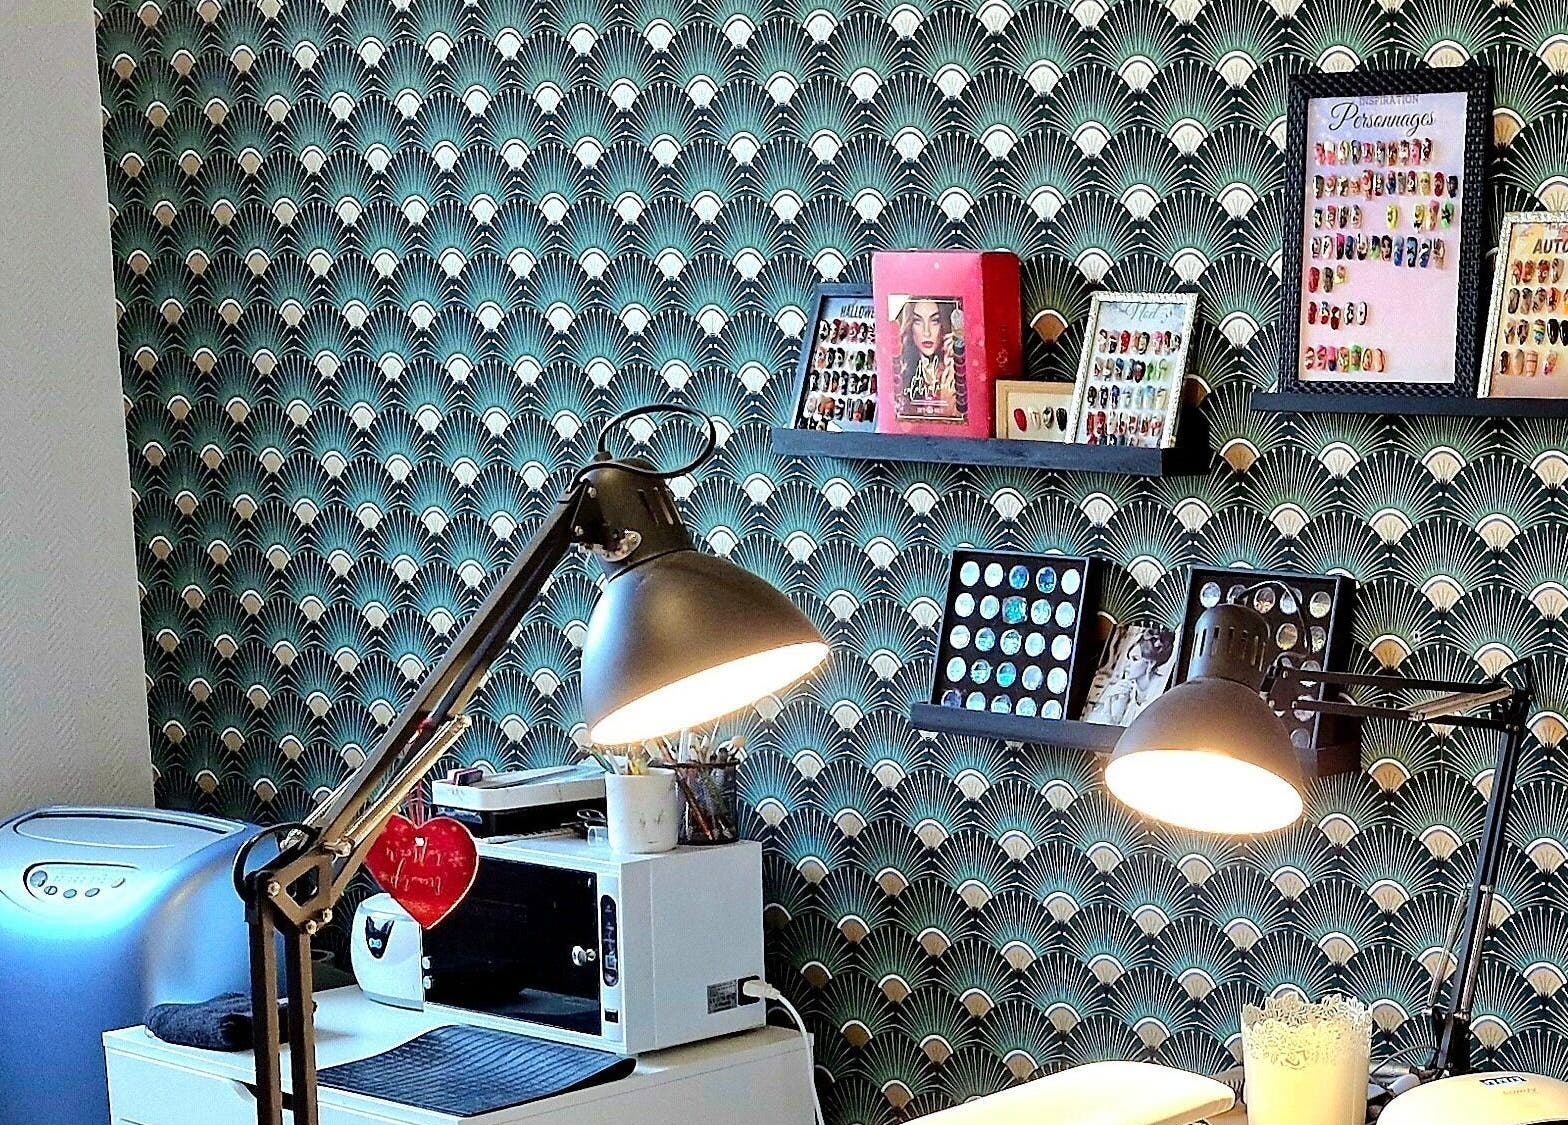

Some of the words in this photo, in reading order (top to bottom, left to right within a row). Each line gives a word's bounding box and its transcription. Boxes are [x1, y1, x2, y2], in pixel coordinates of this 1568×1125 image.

[1360, 94, 1419, 106] INSPIRATION
[1329, 102, 1435, 137] Personnages
[840, 304, 875, 318] HALLOWE
